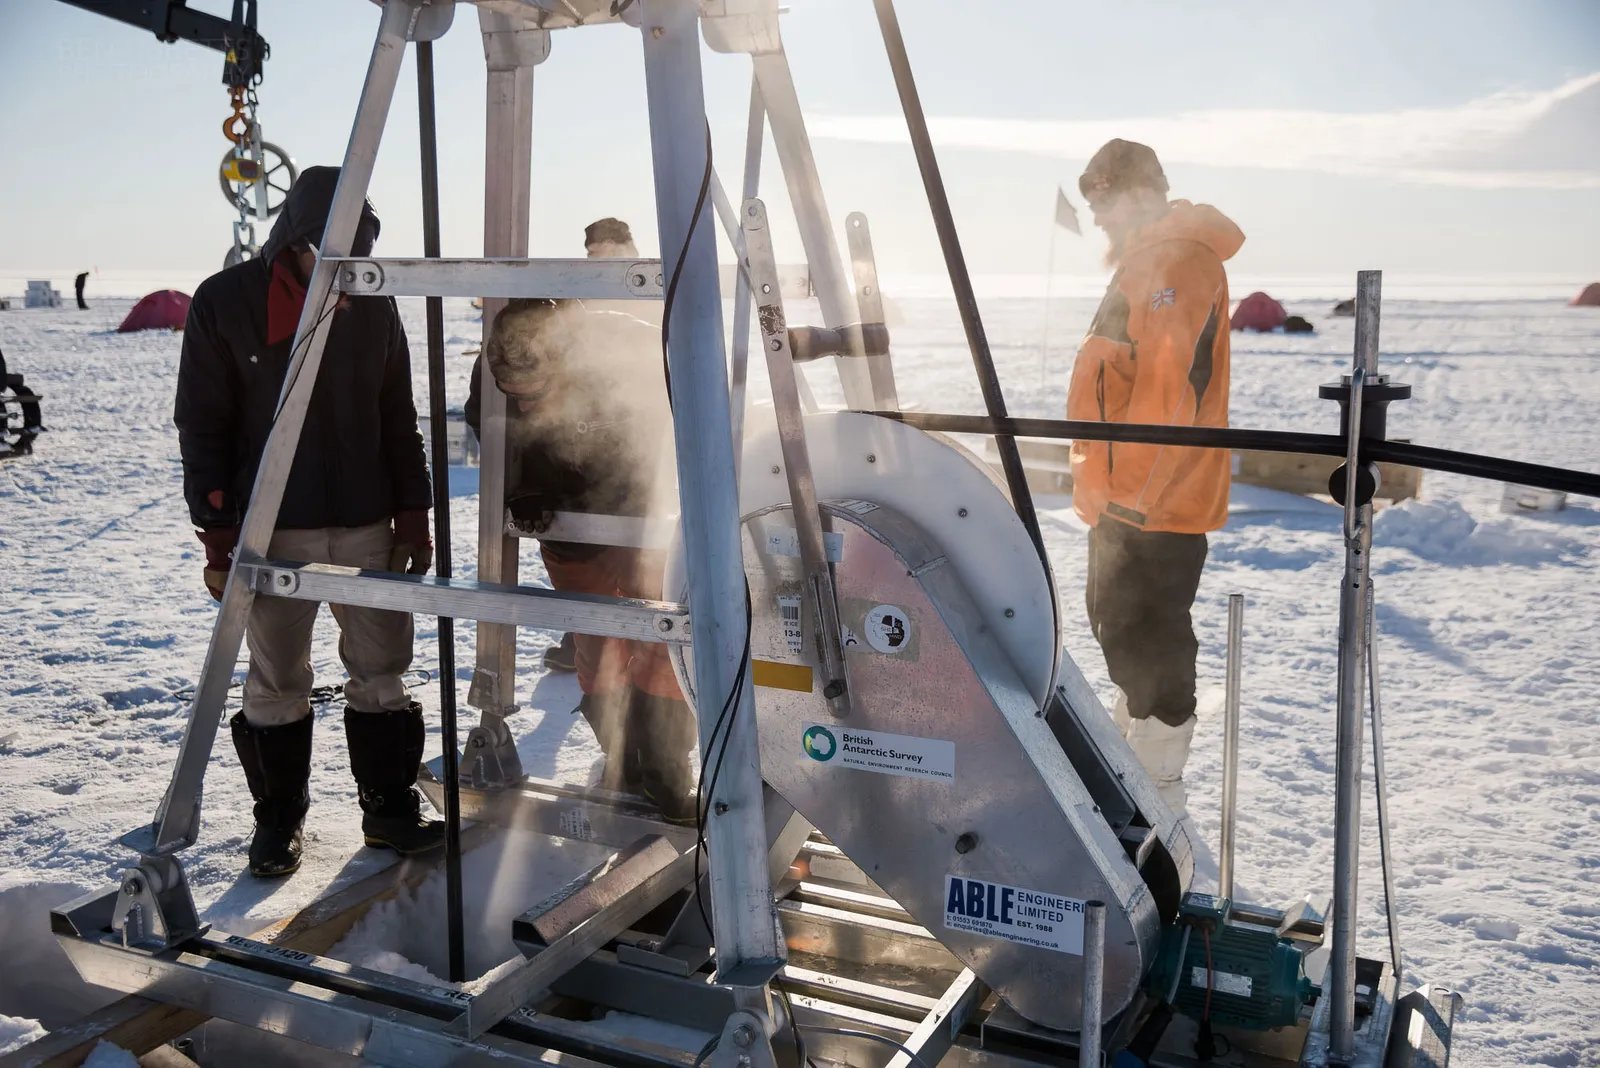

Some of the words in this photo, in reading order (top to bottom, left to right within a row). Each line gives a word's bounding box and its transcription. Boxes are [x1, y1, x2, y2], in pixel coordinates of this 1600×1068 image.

[842, 733, 873, 746] British
[842, 743, 888, 758] Antarctic
[888, 750, 923, 764] Survey
[843, 757, 867, 766] NATURAL
[868, 761, 903, 771] ENVIRONMENT
[930, 770, 953, 778] COUNCIL
[947, 877, 1015, 926] ABLE
[1017, 891, 1085, 914] ENGINEERI
[1017, 905, 1064, 923] LIMITED
[953, 922, 1059, 948] enquiries@ableengineering.co.uk
[1016, 920, 1034, 930] EST.
[1035, 923, 1053, 933] 1988
